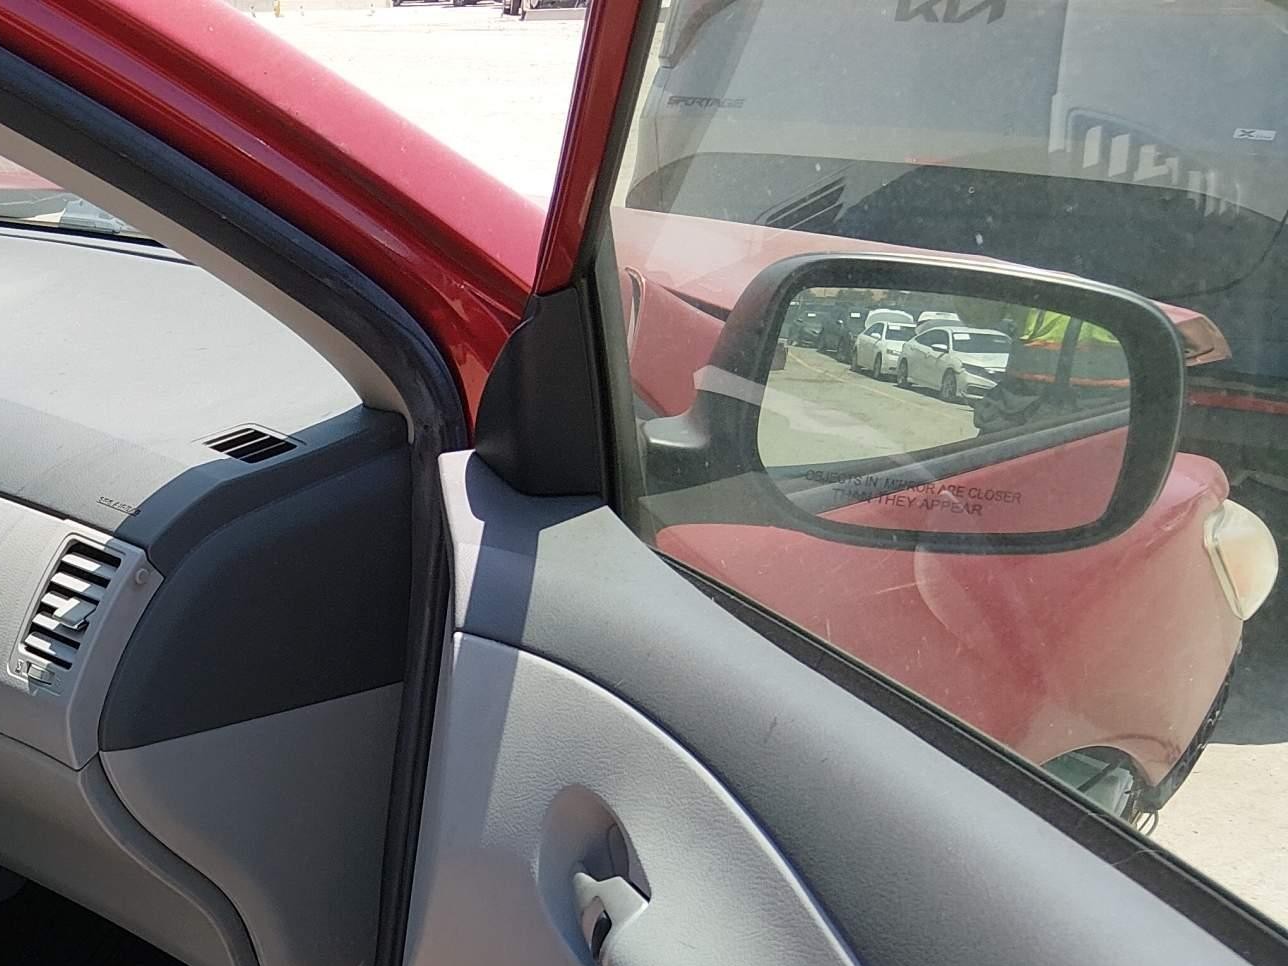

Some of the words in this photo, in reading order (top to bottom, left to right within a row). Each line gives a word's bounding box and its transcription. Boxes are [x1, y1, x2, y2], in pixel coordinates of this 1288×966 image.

[894, 0, 1007, 24] KIA
[806, 469, 862, 486] OBJECTS
[865, 475, 878, 488] IN
[883, 478, 940, 494] MIRROR
[940, 484, 966, 499] ARE
[968, 486, 1022, 504] CLOSER
[832, 487, 872, 503] THAN
[877, 494, 919, 509] THEY
[919, 498, 983, 516] APPEAR
